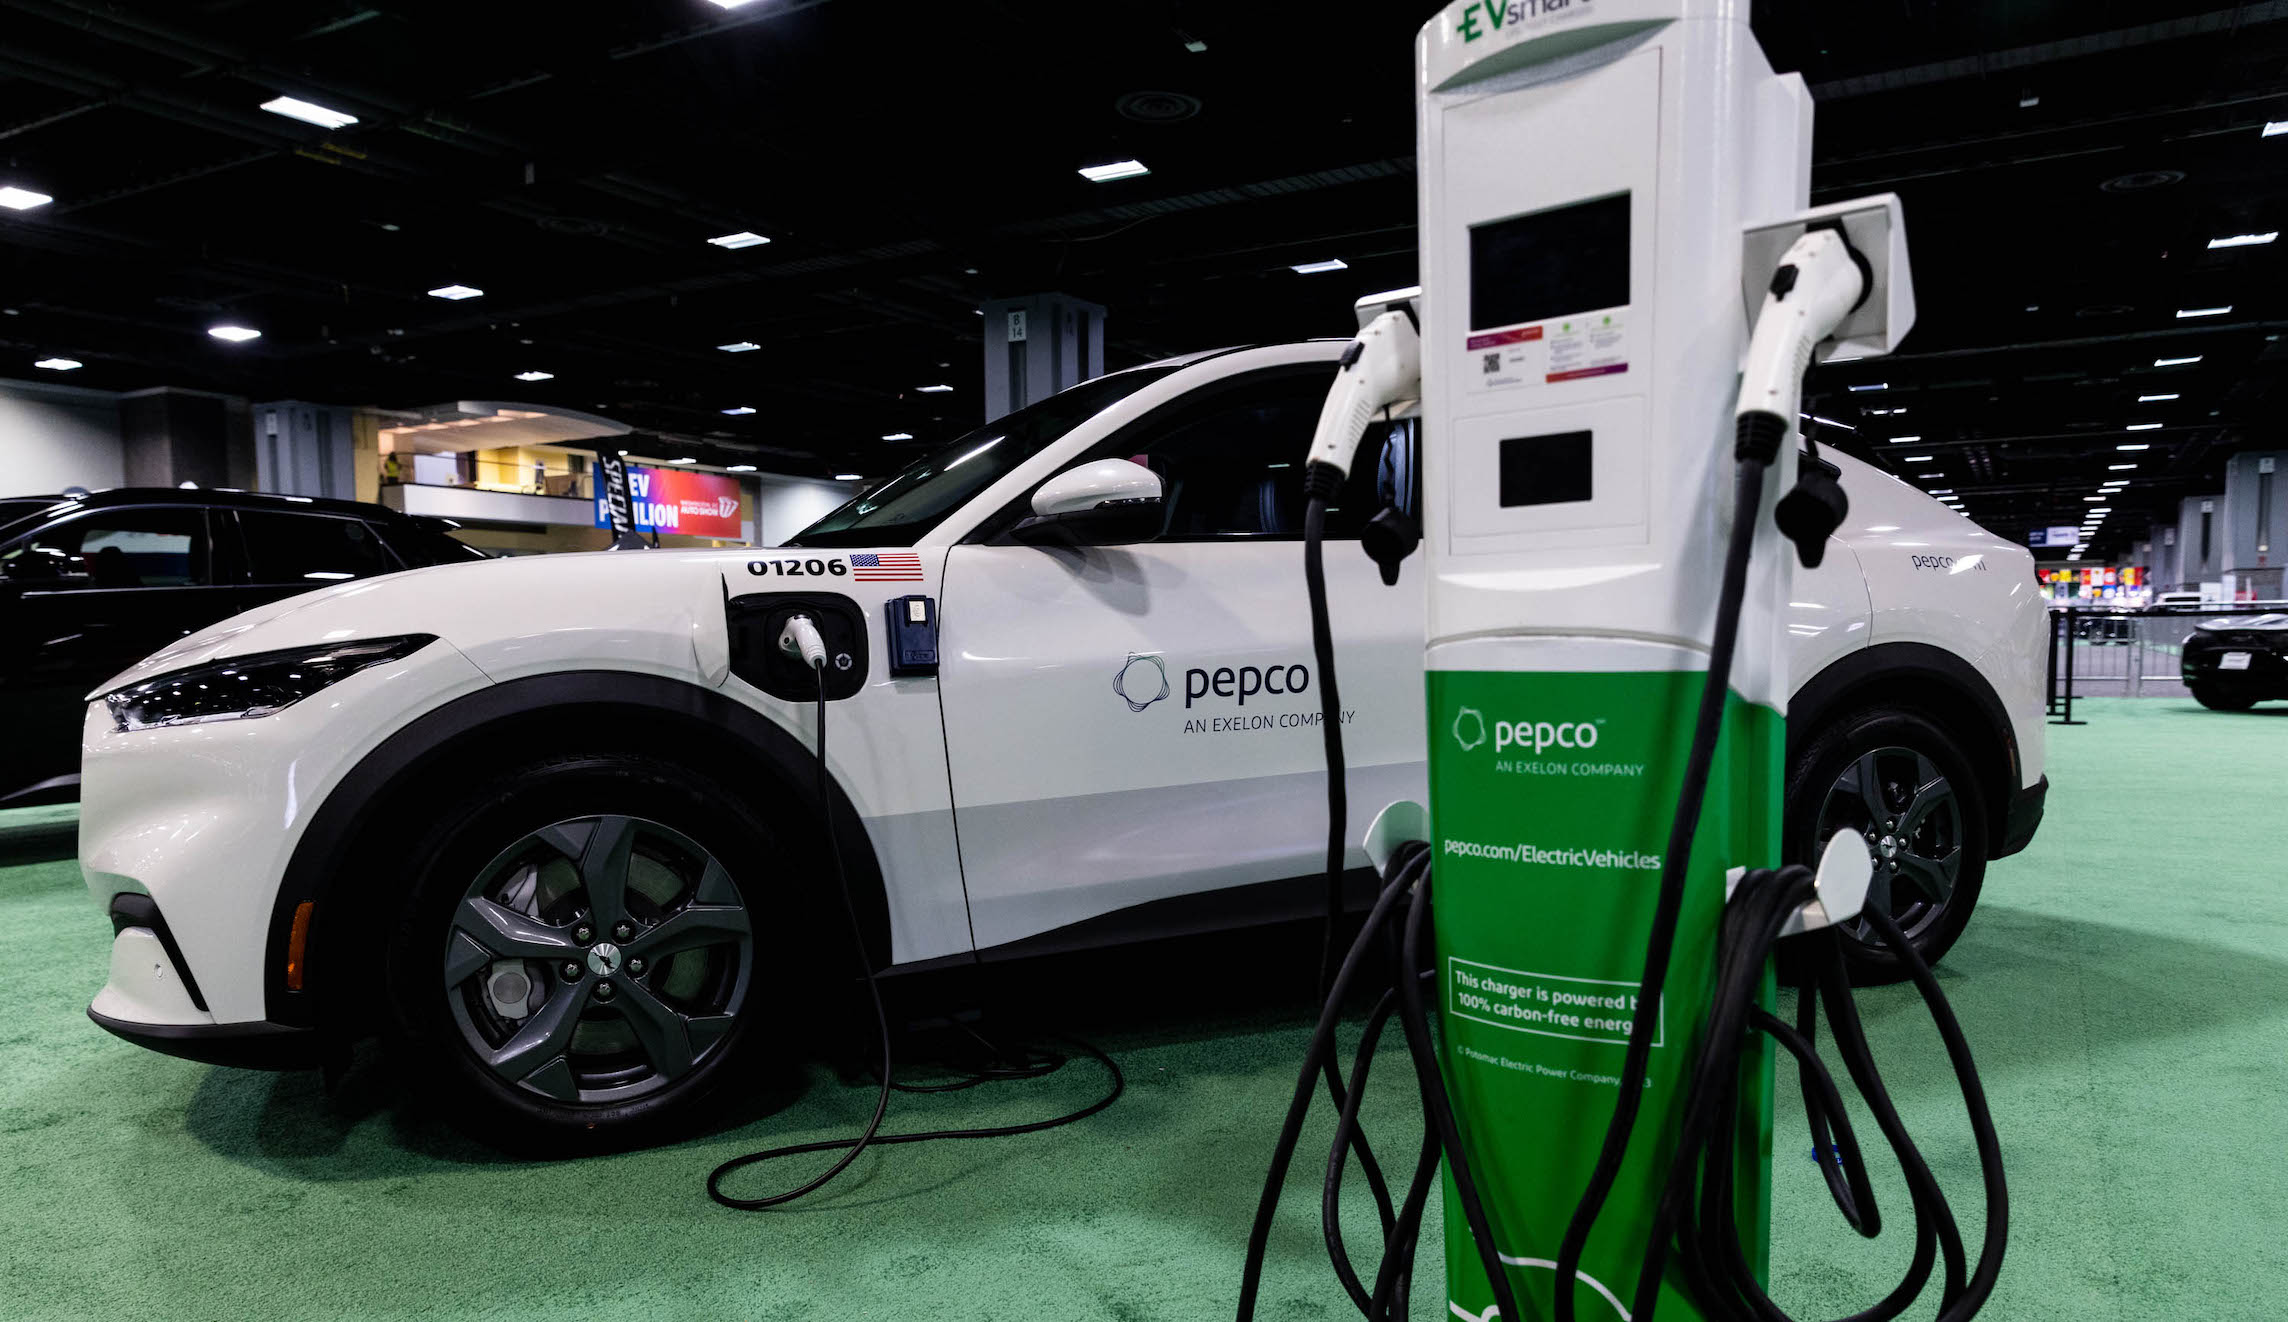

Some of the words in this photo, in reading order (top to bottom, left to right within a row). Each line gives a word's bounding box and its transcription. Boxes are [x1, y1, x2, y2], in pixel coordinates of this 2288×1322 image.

[627, 472, 650, 498] EV
[598, 498, 679, 528] PILION
[747, 558, 847, 577] 01206
[1185, 664, 1310, 709] pepco
[1184, 719, 1207, 734] AN
[1213, 715, 1274, 732] EXELON
[1279, 710, 1356, 728] COMPNY
[1495, 721, 1598, 755] pepco
[1495, 761, 1513, 773] AN
[1516, 761, 1568, 775] EXELON
[1571, 763, 1645, 776] COMPANY
[1444, 839, 1661, 870] pepco.com/ElectricVehicles
[1455, 970, 1479, 989] This
[1481, 977, 1532, 1000] charger
[1536, 986, 1549, 1001] is
[1552, 992, 1626, 1010] powered
[1458, 992, 1491, 1012] 100%
[1493, 1003, 1580, 1027] carbon-free
[1584, 1016, 1633, 1035] energ
[1464, 1047, 1499, 1066] Potomac
[1500, 1057, 1535, 1073] Electric
[1535, 1064, 1568, 1079] Power
